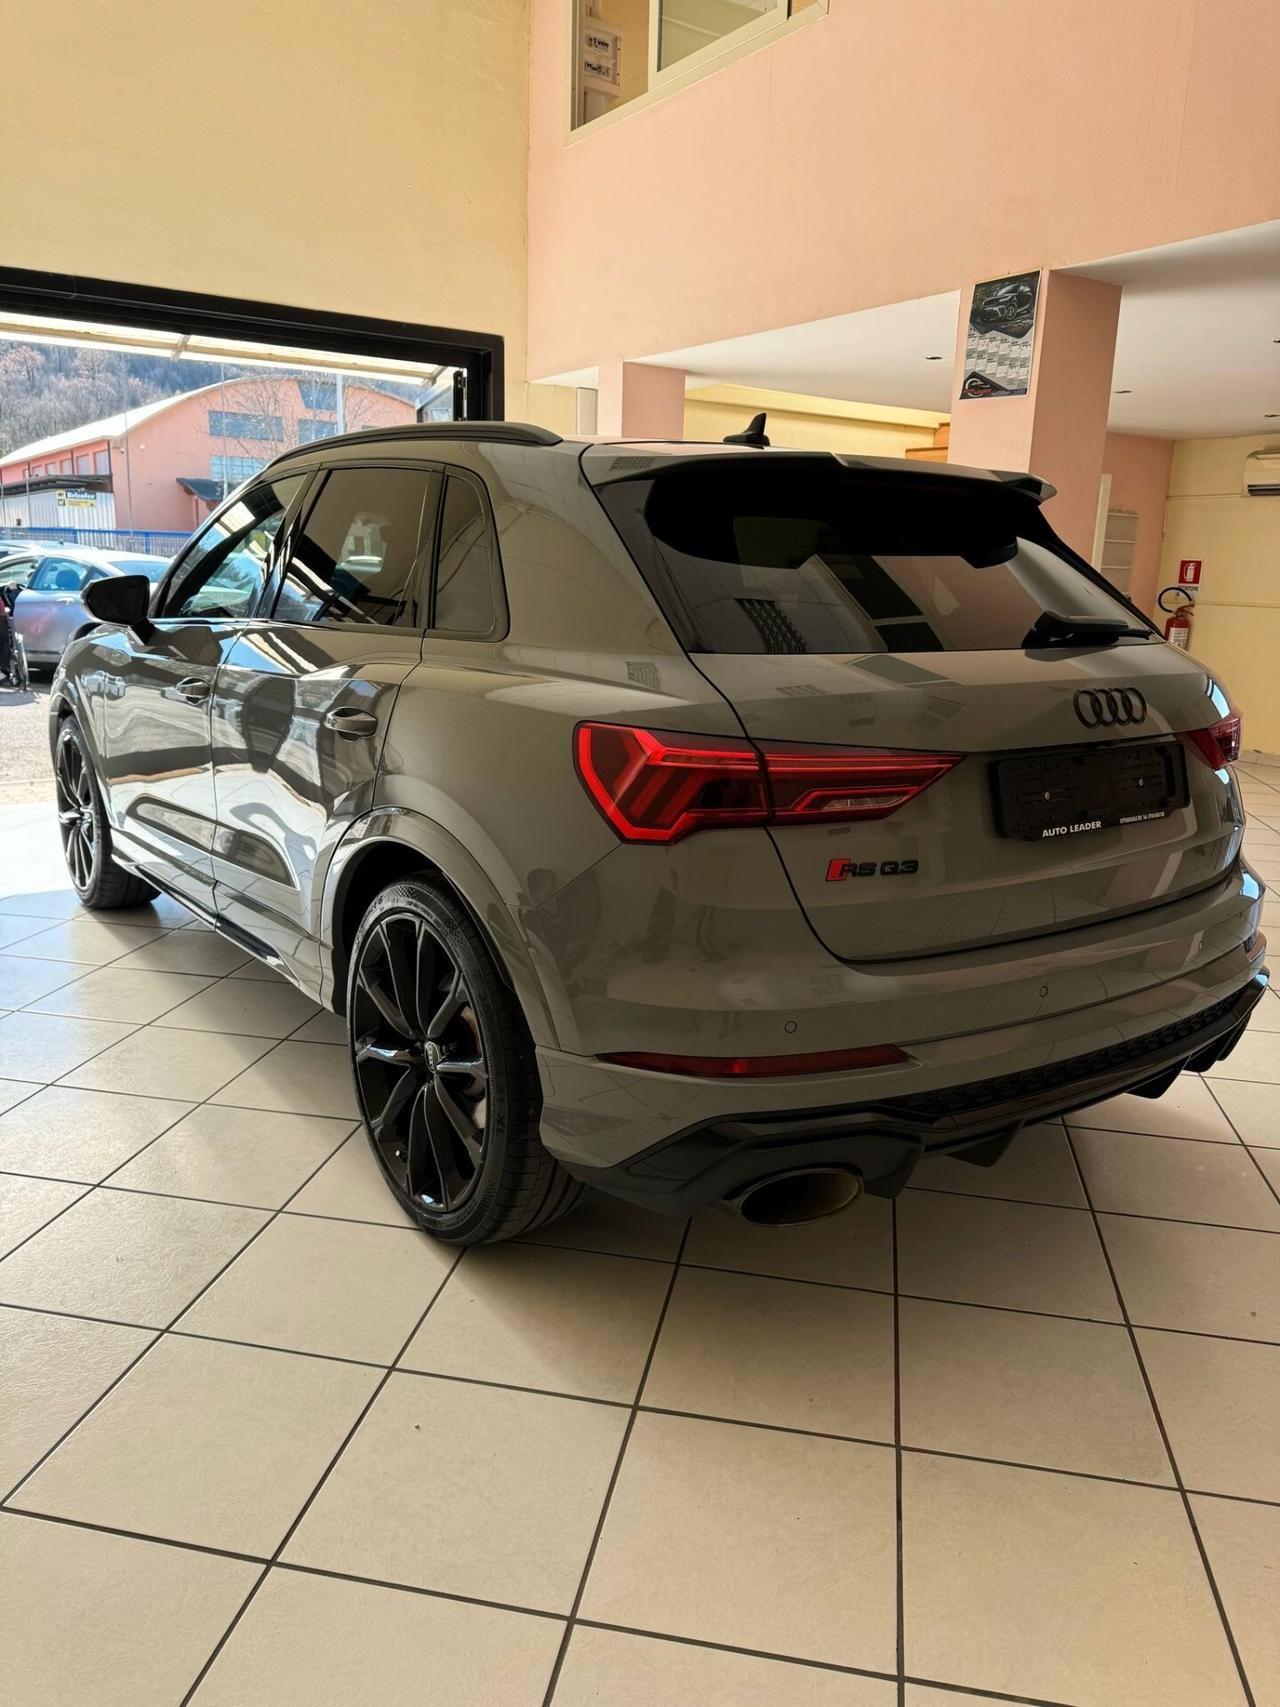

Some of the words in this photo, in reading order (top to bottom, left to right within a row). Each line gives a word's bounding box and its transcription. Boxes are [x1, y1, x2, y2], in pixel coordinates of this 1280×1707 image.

[1042, 826, 1067, 838] AUTO
[1070, 820, 1102, 833] LEADER
[839, 862, 877, 877] RS
[880, 860, 919, 876] Q3
